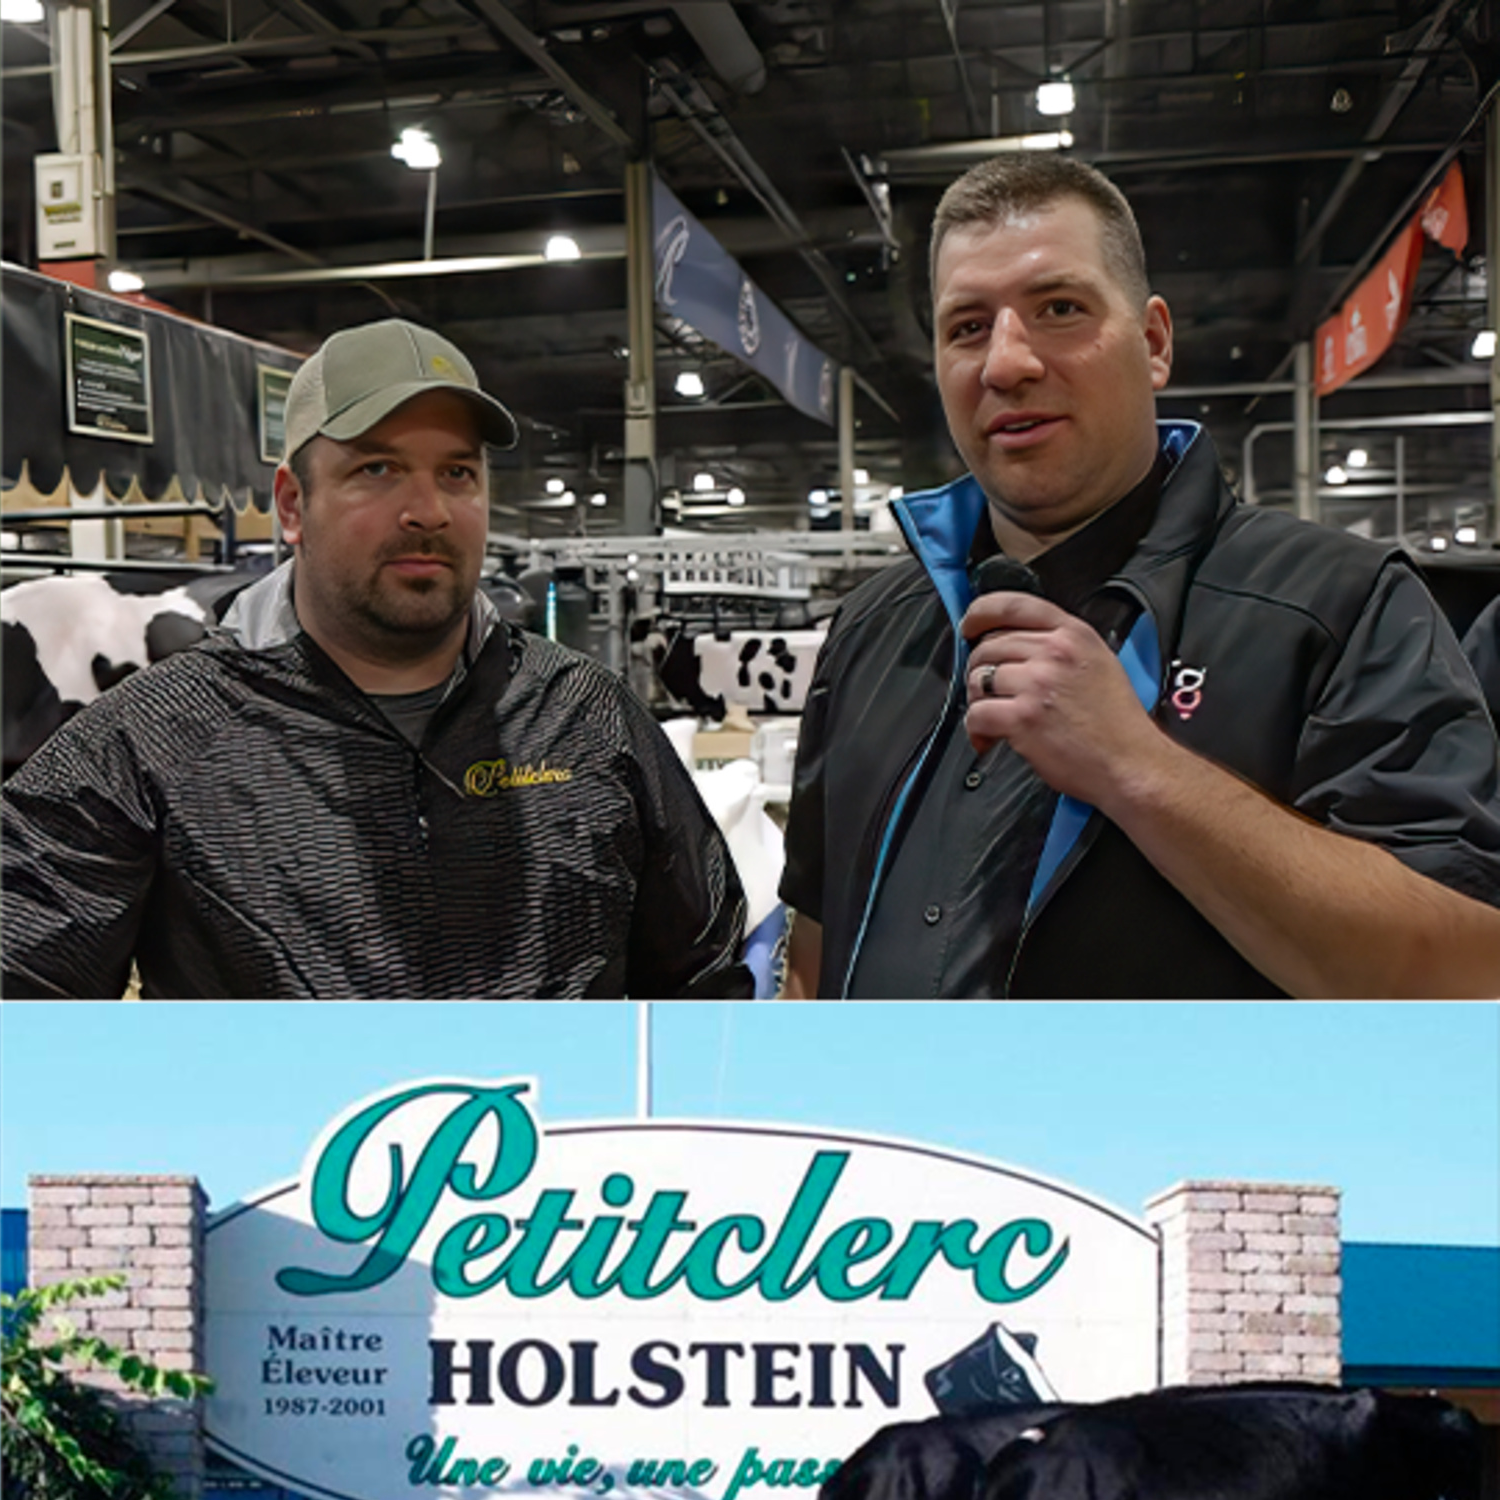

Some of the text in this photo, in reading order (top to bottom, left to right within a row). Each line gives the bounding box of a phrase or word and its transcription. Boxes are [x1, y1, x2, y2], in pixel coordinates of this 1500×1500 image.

[274, 1082, 1070, 1304] Petitclerc
[267, 1324, 383, 1352] Maître
[262, 1351, 388, 1386] Éleveur
[428, 1338, 906, 1409] HOLSTEIN
[264, 1397, 386, 1416] 1987-2001
[405, 1432, 510, 1488] Une
[526, 1443, 616, 1496] vie,
[625, 1456, 719, 1489] une
